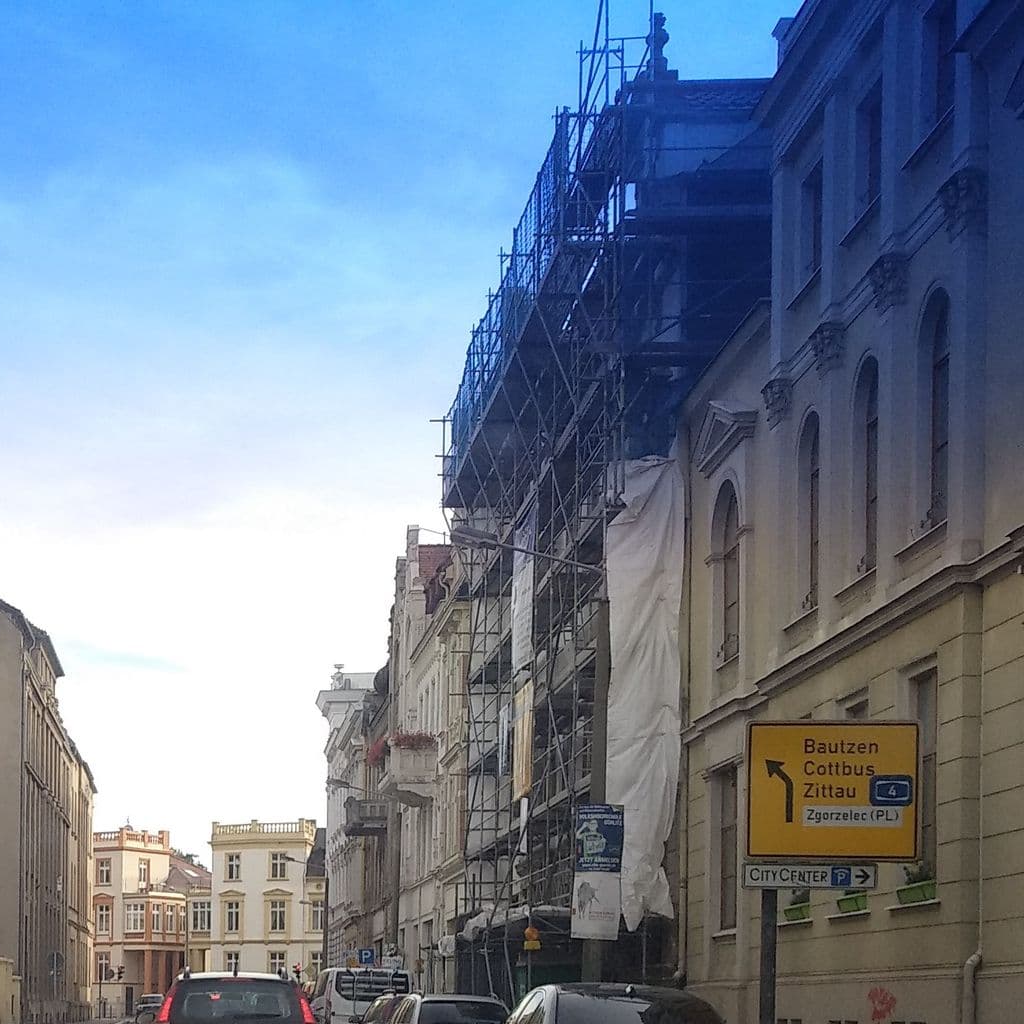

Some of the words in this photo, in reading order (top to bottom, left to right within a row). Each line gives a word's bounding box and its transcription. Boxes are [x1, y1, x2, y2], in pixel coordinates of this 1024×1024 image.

[804, 738, 879, 754] Bautzen
[804, 760, 875, 776] Cottbus
[804, 782, 856, 798] Zittau
[888, 784, 896, 796] 4
[806, 809, 867, 823] Zgorzelec
[870, 810, 899, 821] (PL)
[362, 950, 371, 962] P
